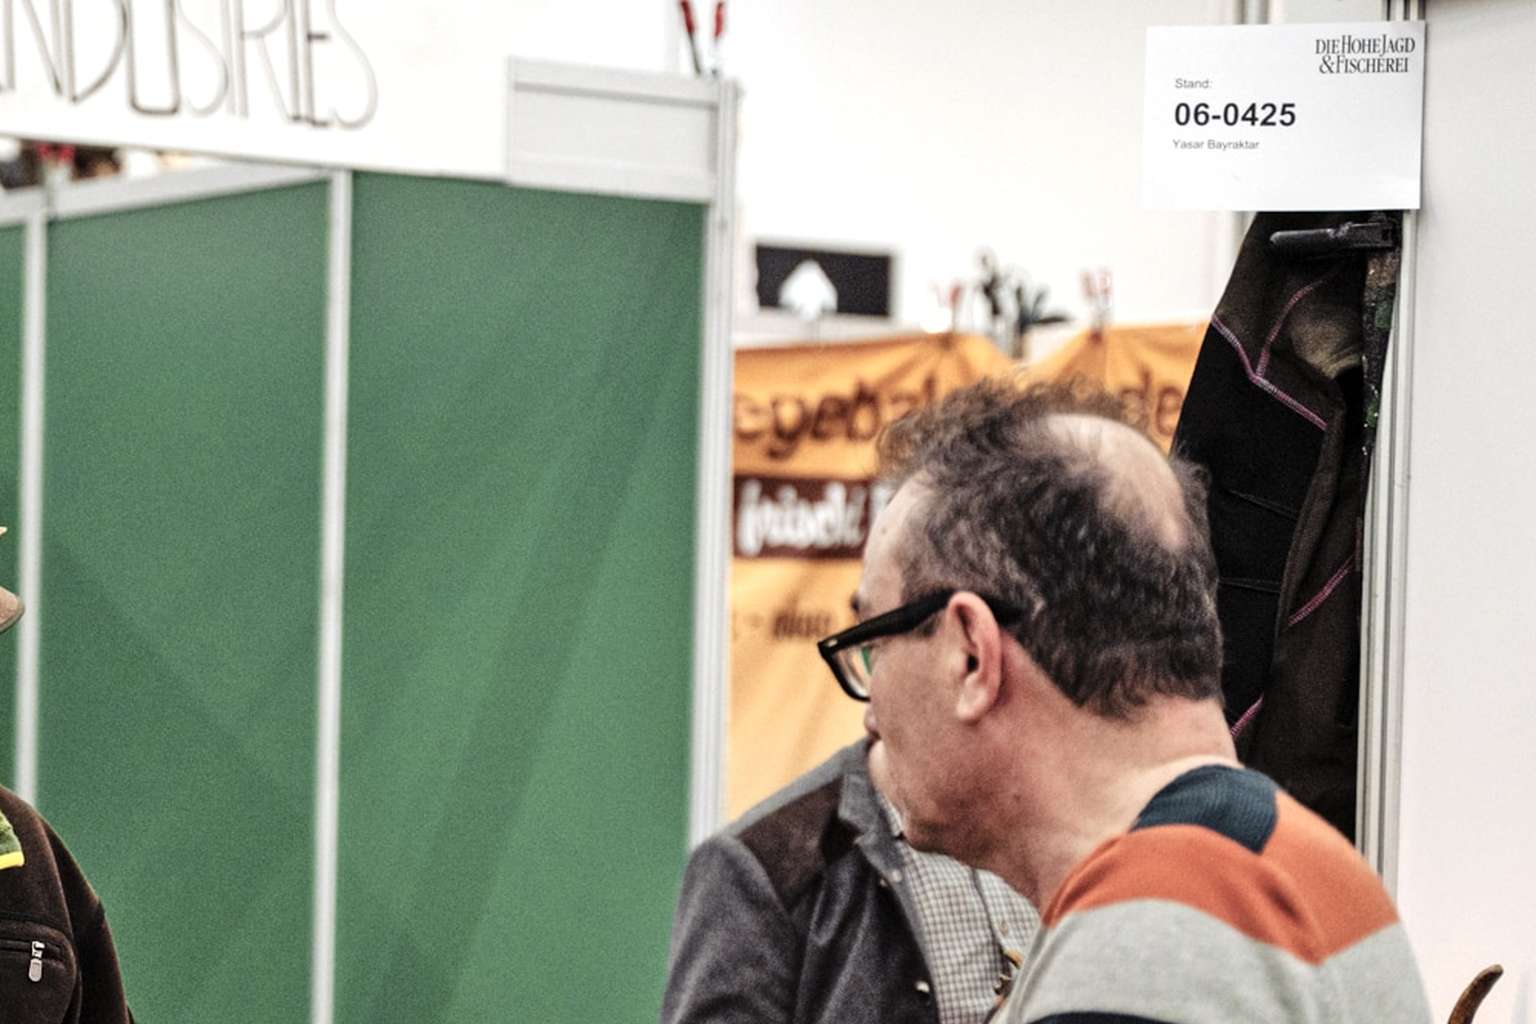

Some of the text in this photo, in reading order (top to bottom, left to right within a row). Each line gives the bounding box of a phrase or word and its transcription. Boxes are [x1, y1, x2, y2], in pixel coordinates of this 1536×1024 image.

[1174, 77, 1213, 89] Stand:
[1174, 102, 1296, 127] 06-0425
[1172, 139, 1261, 151] Yasar Bayraktar
